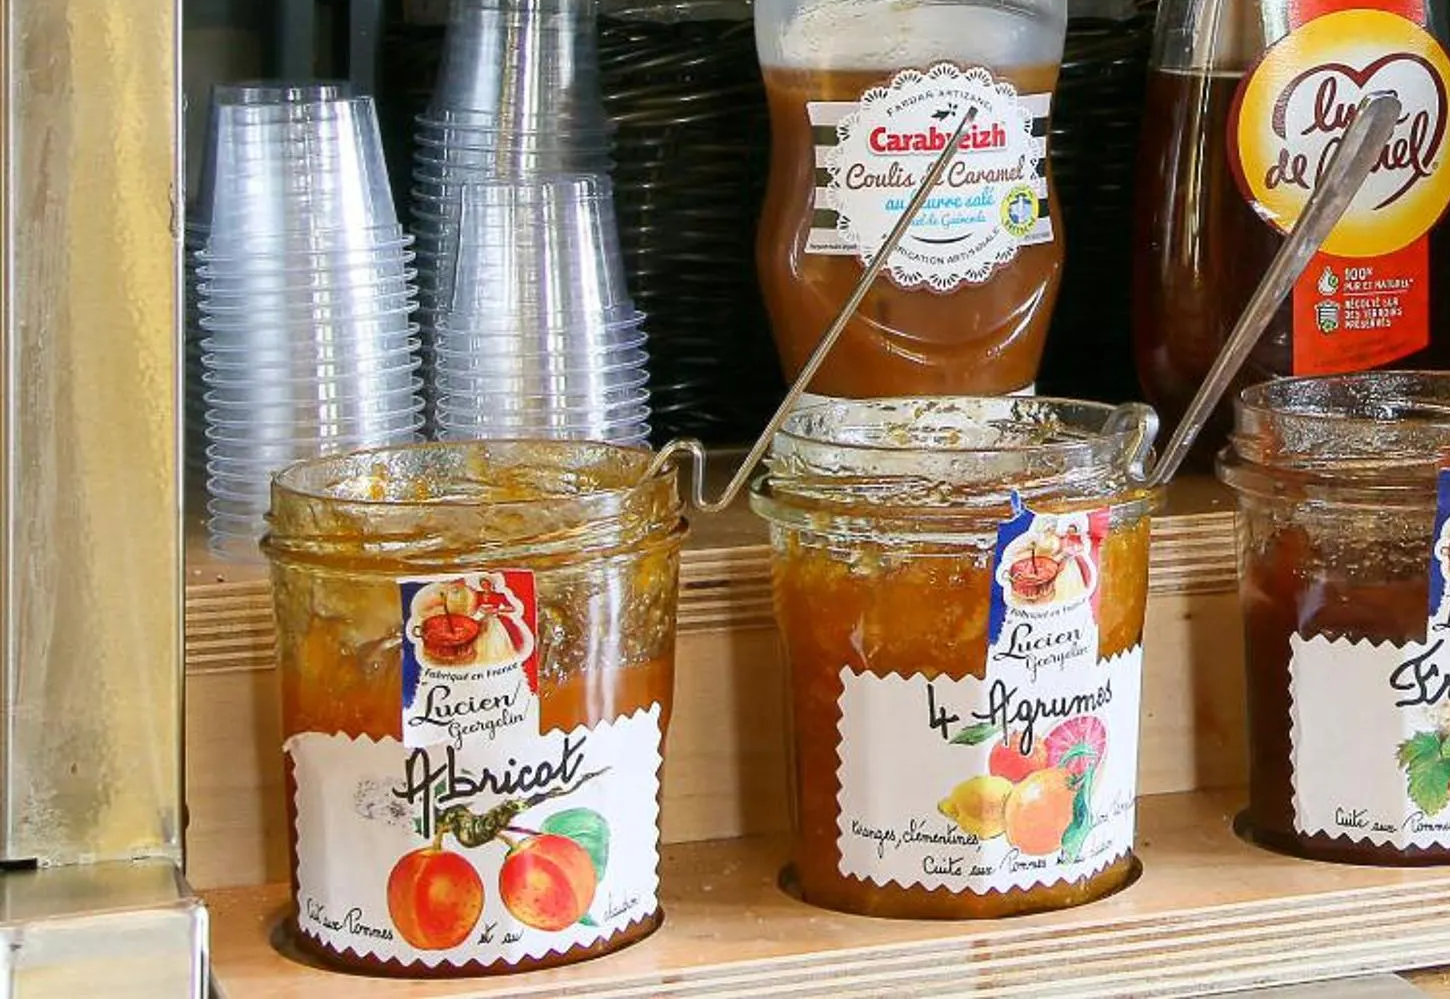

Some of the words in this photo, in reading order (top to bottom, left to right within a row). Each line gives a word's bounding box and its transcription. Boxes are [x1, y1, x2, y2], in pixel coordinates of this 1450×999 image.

[870, 122, 1007, 153] Carabeizh
[845, 161, 916, 190] Coulis
[947, 155, 1026, 189] Caramel
[1264, 147, 1311, 190] de
[884, 199, 905, 212] au
[993, 622, 1081, 661] Lucien
[408, 680, 521, 728] Lucien
[927, 683, 959, 740] 4
[972, 676, 1112, 756] Agrumes
[393, 735, 586, 839] Abricot
